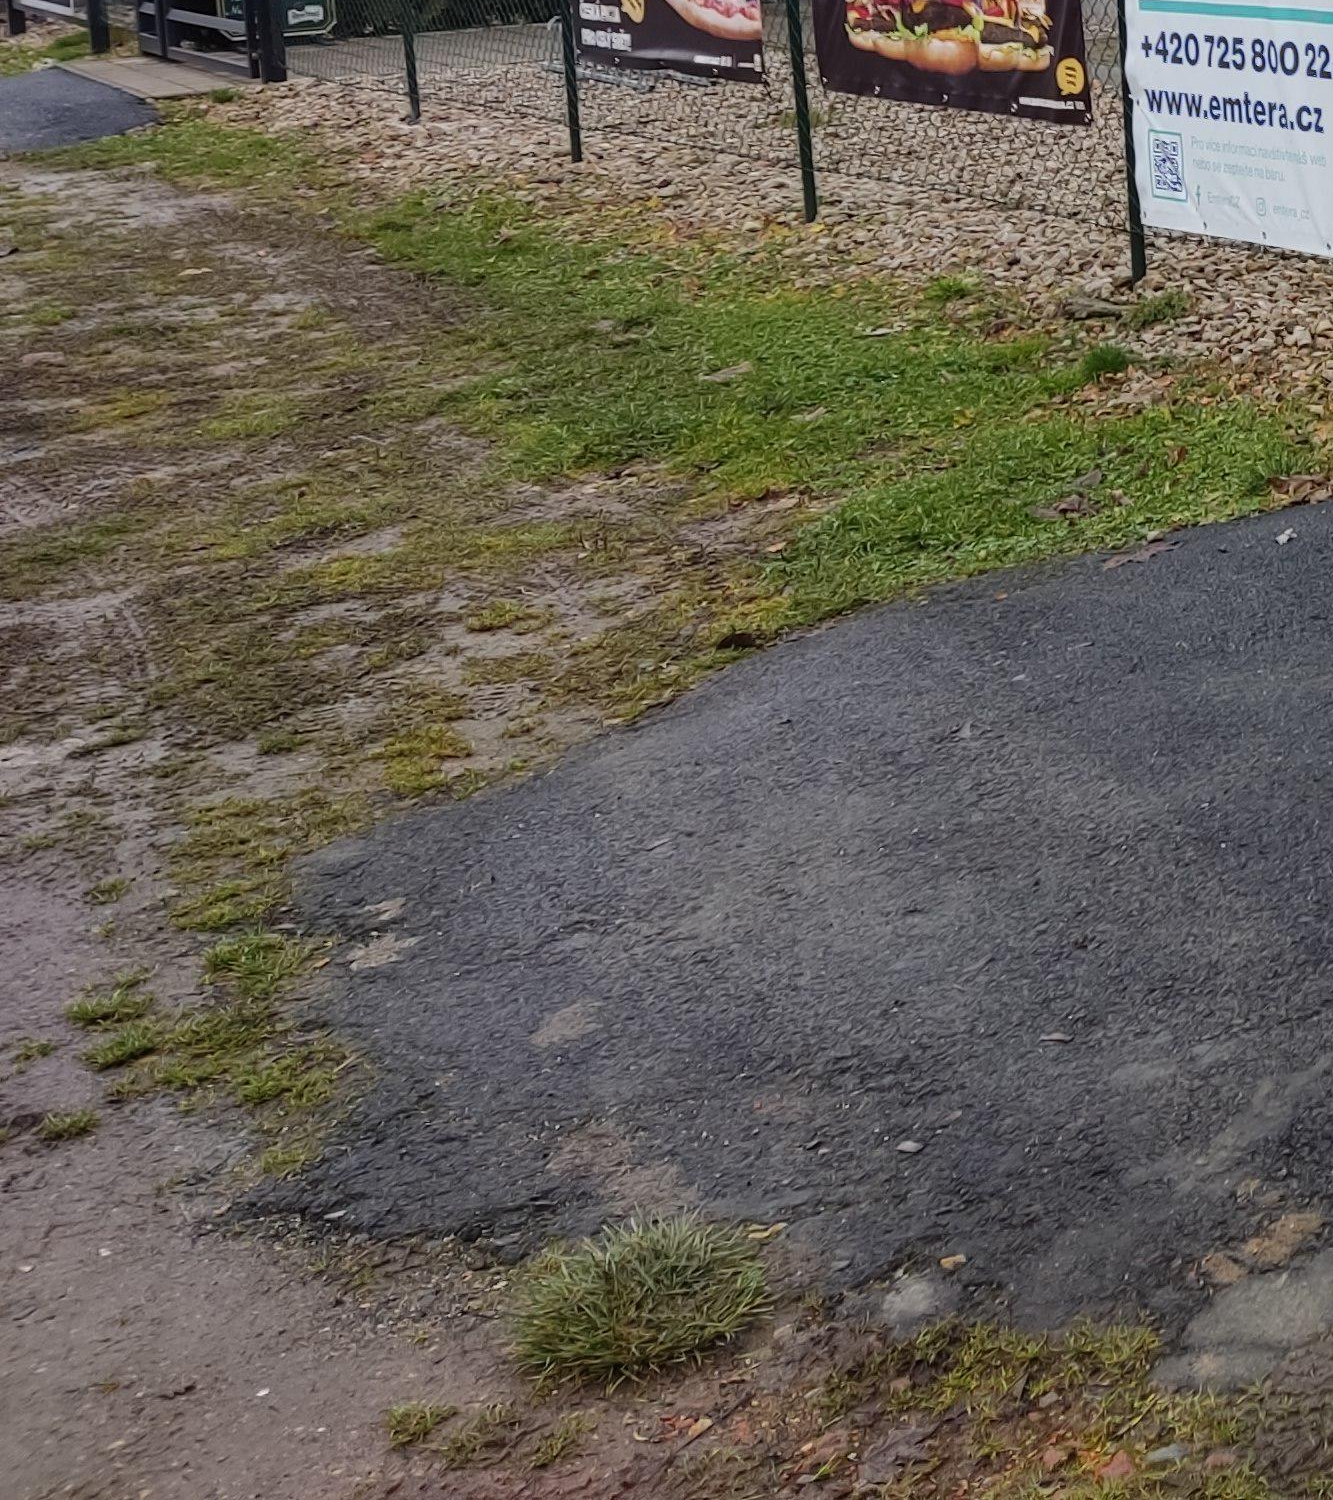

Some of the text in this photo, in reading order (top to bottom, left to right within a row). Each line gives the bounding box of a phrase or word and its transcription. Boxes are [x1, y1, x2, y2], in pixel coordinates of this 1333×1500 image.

[1141, 31, 1200, 67] +420
[1204, 35, 1246, 71] 725
[1251, 38, 1299, 76] 800
[1144, 88, 1325, 134] www.emtera.cz
